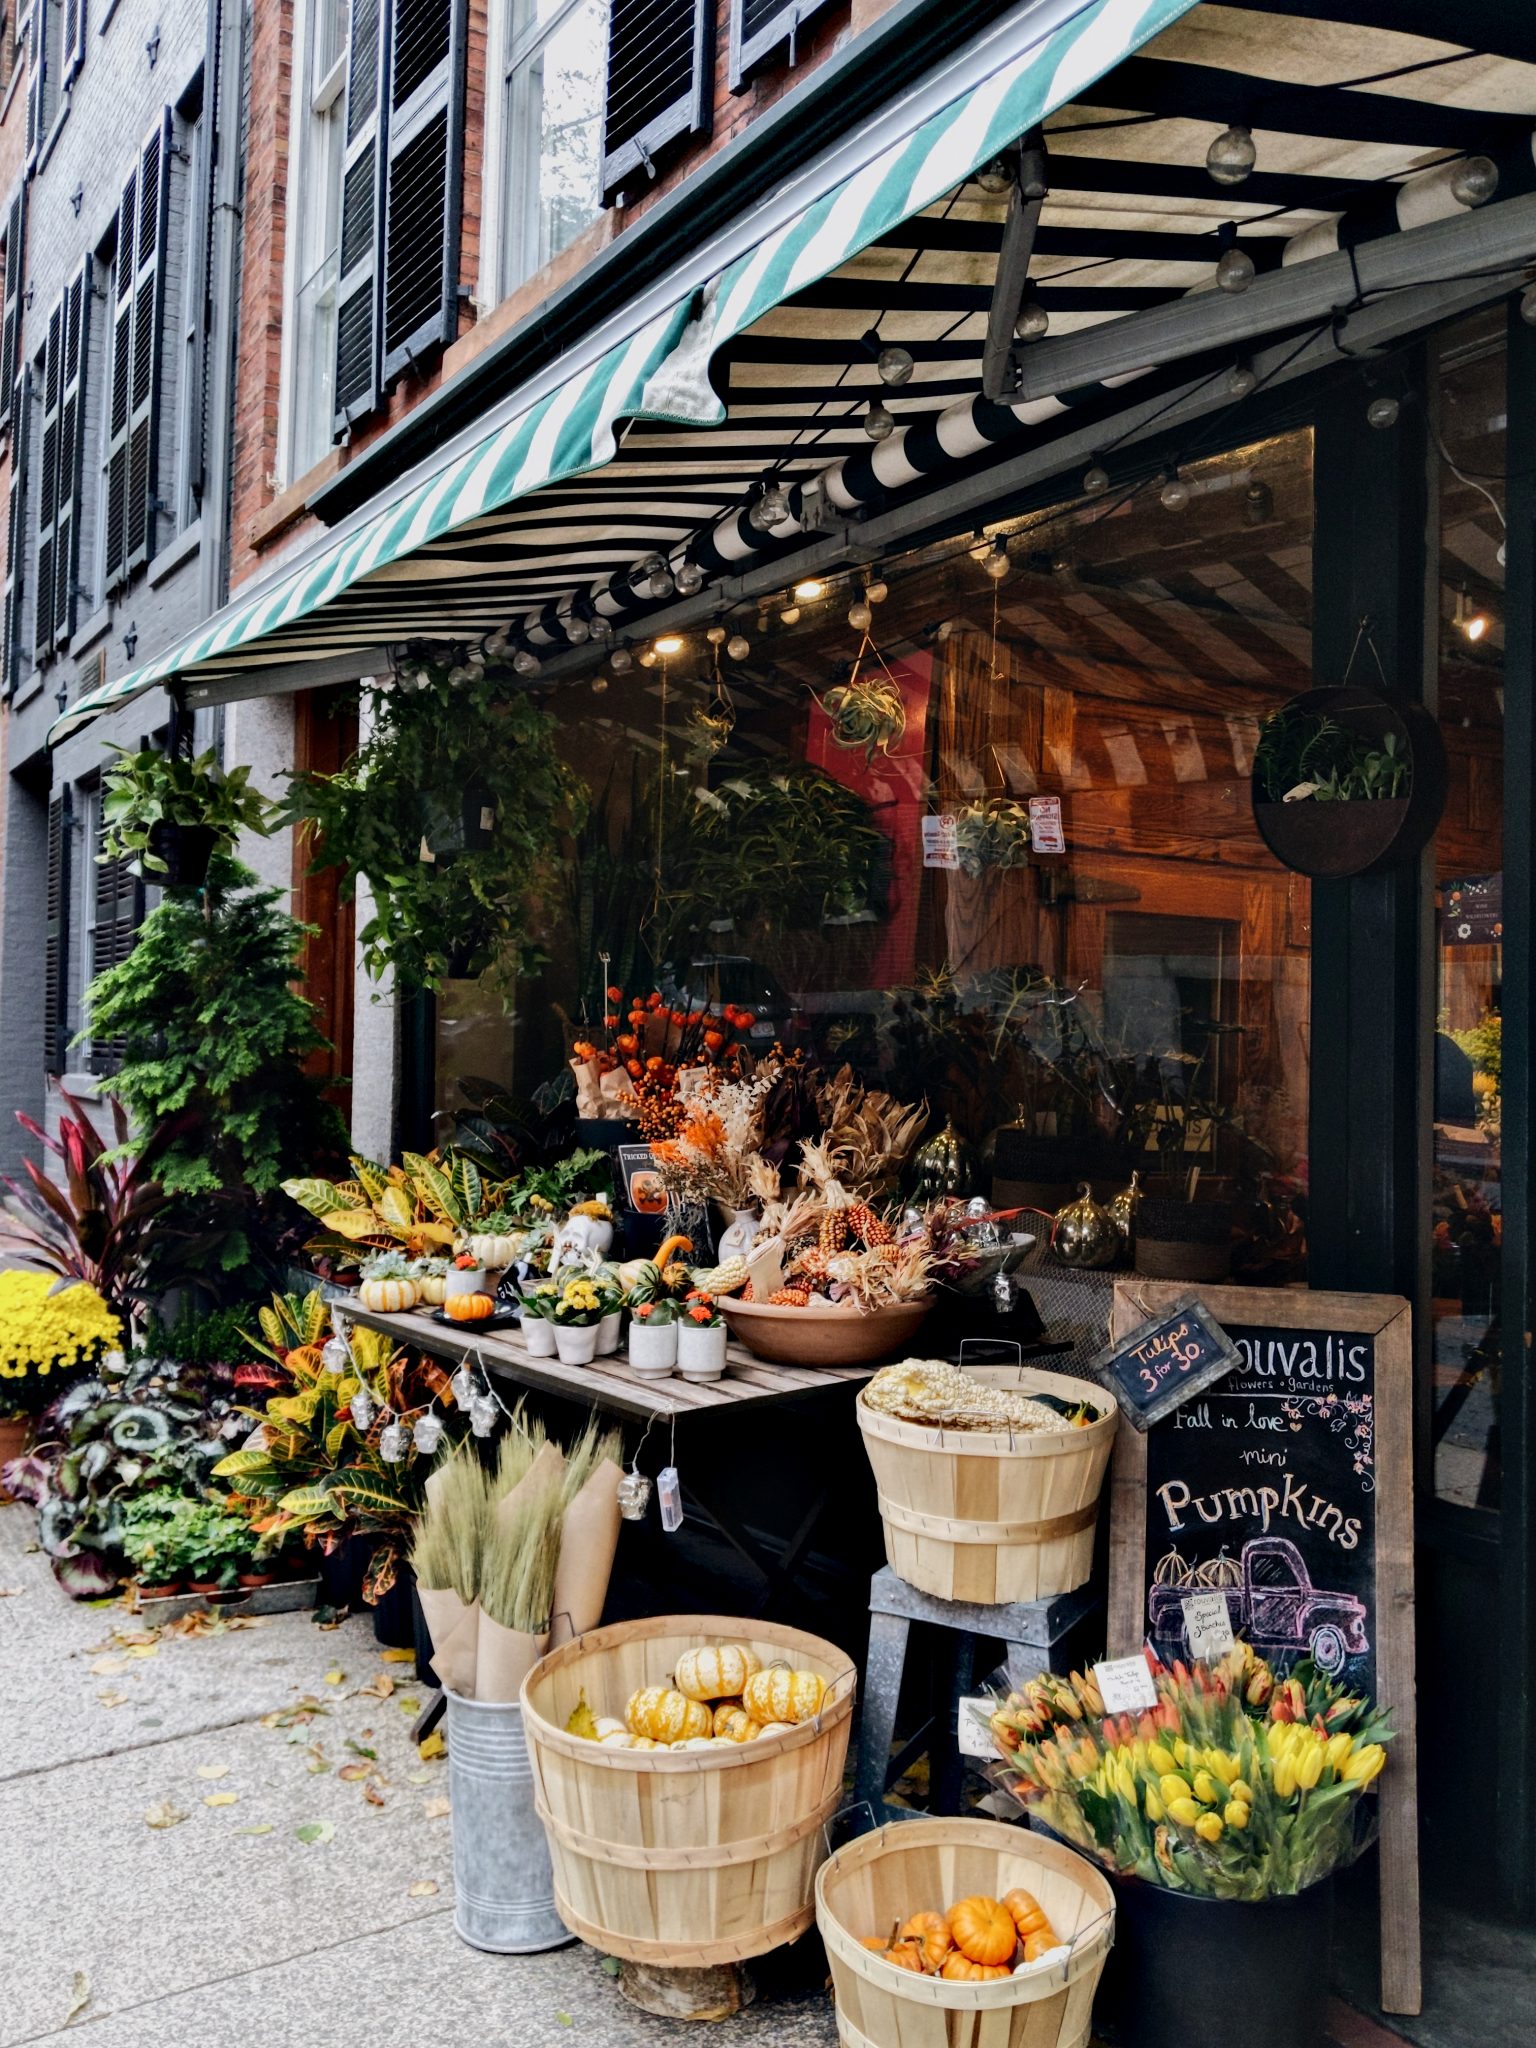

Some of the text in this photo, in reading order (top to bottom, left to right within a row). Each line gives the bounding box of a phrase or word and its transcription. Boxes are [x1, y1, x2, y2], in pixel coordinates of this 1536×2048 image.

[1128, 1323, 1189, 1365] Tulips
[1234, 1335, 1368, 1381] ouvalis
[1139, 1368, 1158, 1393] 3
[1154, 1360, 1171, 1379] for
[1228, 1376, 1334, 1393] flowers gardens
[1174, 1402, 1288, 1432] Fall in love
[1239, 1448, 1288, 1467] mini
